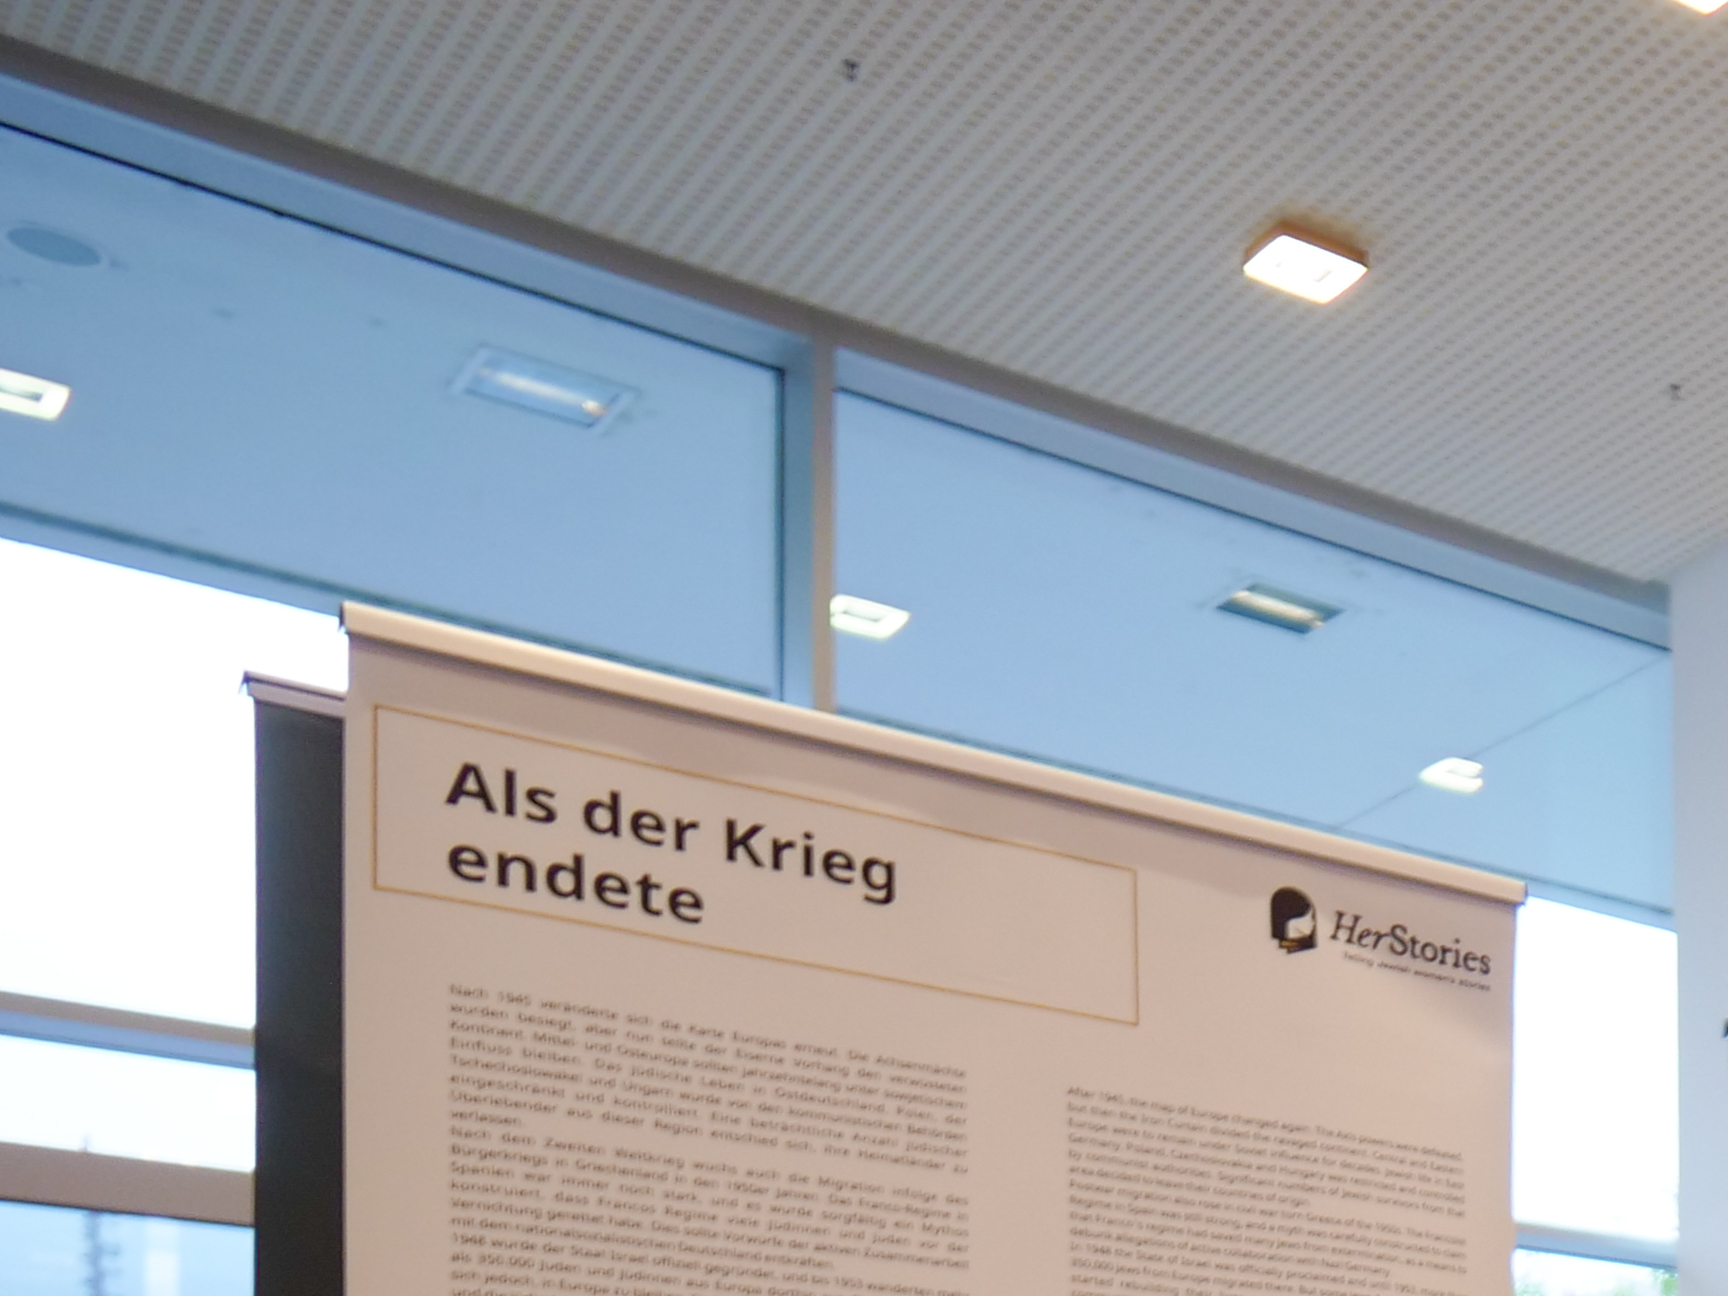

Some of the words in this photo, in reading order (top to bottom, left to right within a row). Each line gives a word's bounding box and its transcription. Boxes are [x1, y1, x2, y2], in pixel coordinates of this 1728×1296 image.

[446, 762, 558, 824] Als
[582, 790, 699, 852] der
[725, 818, 896, 905] Krieg
[447, 841, 705, 924] endete
[1330, 910, 1492, 975] HerStories
